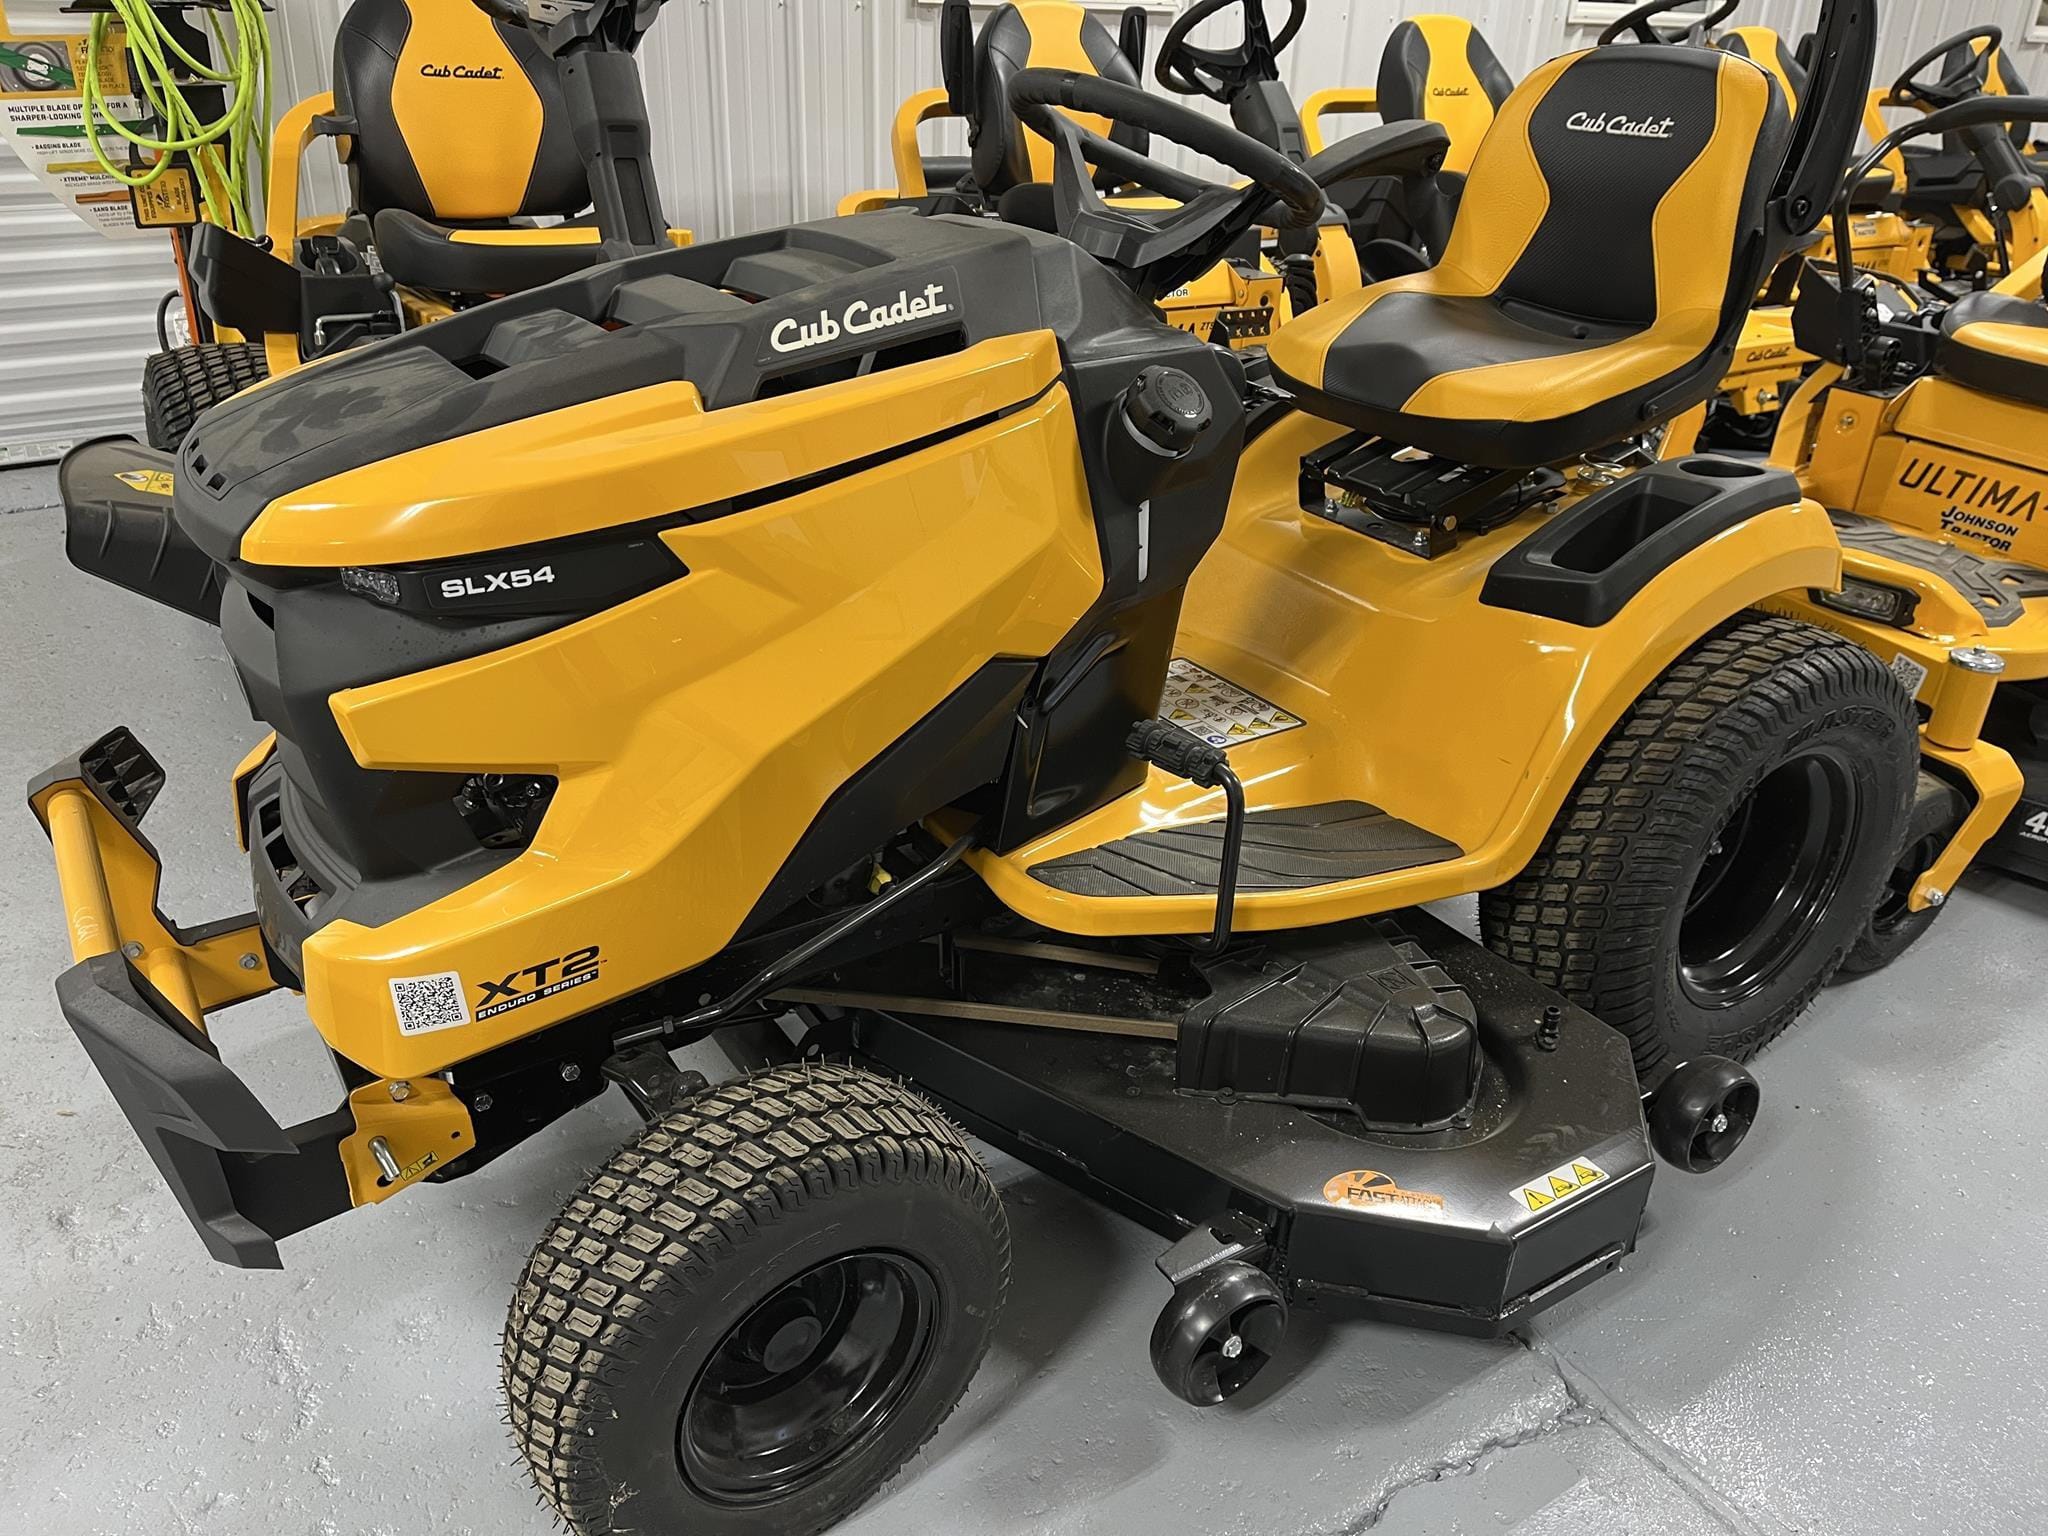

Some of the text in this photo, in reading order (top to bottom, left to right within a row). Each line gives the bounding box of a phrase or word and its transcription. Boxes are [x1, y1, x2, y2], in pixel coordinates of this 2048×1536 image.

[421, 64, 503, 79] Cub Cadet
[8, 105, 46, 113] MULTIPLE
[47, 104, 71, 112] BLADE
[10, 112, 81, 121] SHARPER-LOOKING
[1566, 112, 1674, 138] Cub Cadet
[771, 284, 948, 352] Cub Cadet
[1898, 458, 2041, 522] ULTIMA
[1941, 505, 2019, 537] JOHNSON
[441, 566, 555, 598] SLX54
[476, 946, 599, 1008] XT2
[478, 994, 536, 1019] ENDURO
